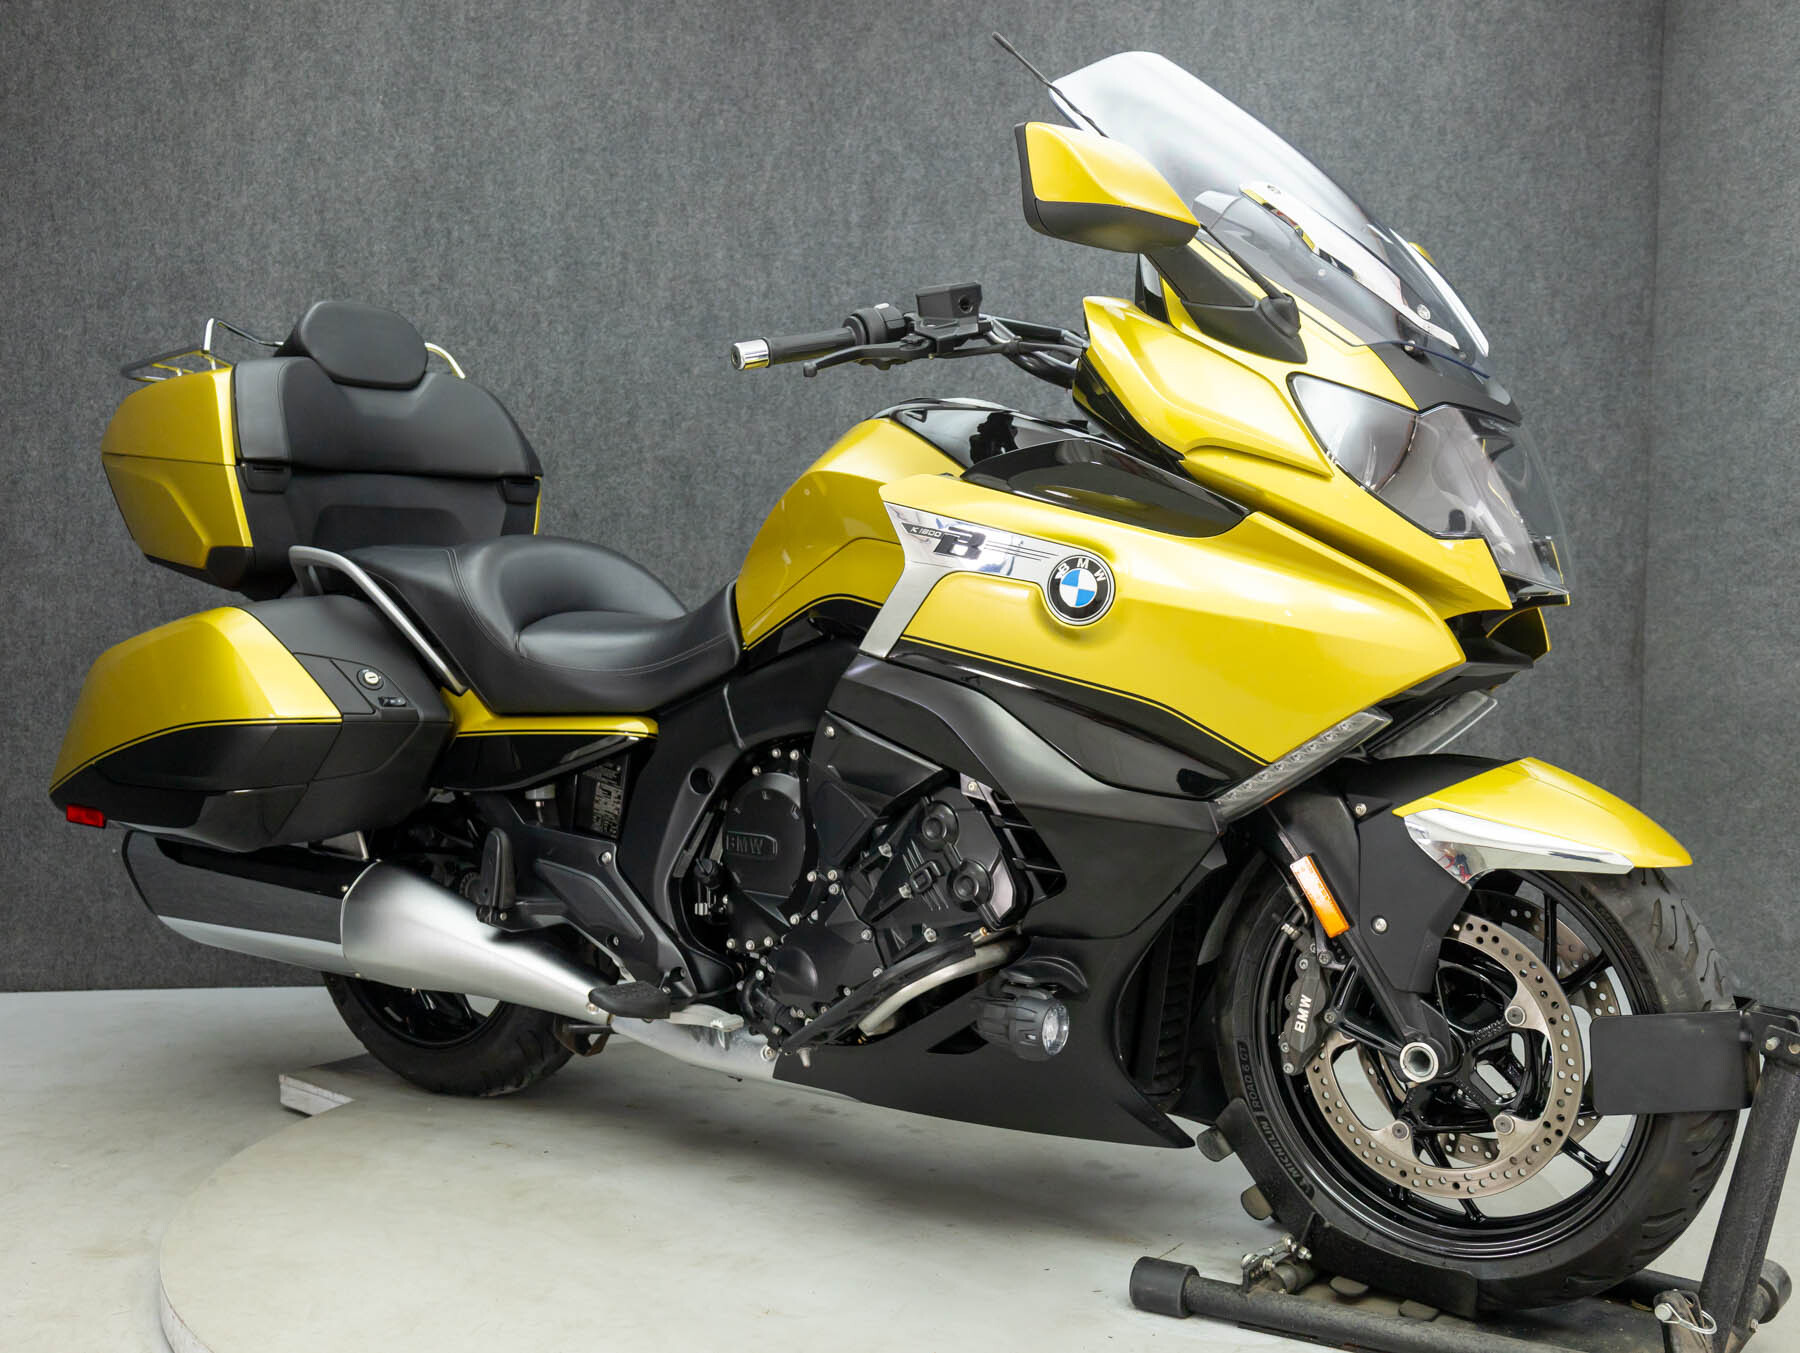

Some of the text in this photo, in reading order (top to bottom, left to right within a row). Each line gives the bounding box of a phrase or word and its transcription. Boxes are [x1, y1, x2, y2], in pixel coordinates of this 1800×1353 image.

[1055, 557, 1106, 582] BMW
[727, 835, 764, 854] BMW
[1294, 994, 1313, 1034] BMW
[1244, 1075, 1262, 1109] ROAD
[1260, 1120, 1301, 1178] MICHELIN
